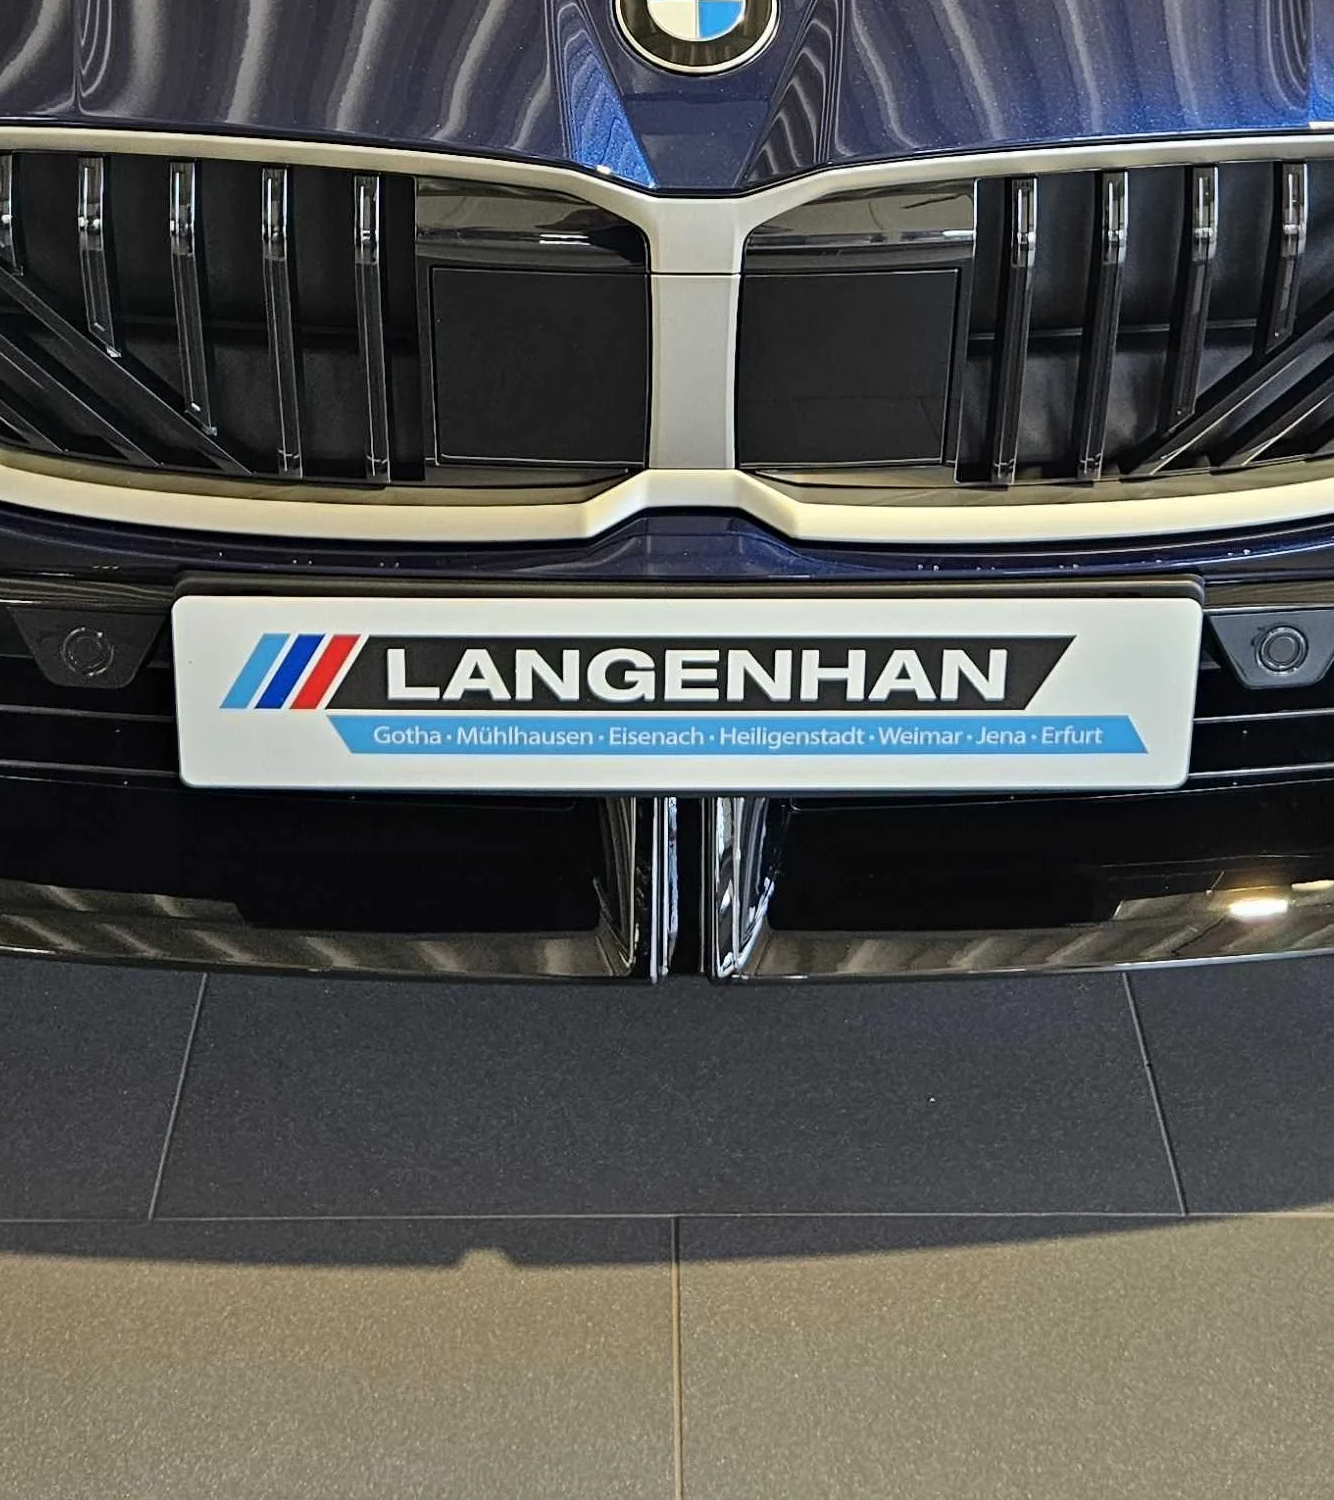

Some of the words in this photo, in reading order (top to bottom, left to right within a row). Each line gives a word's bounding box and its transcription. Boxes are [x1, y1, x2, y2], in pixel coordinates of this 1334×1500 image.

[386, 648, 1009, 702] LANGENHAN
[373, 725, 443, 745] Gotha
[457, 725, 593, 746] Mühlhausen
[609, 726, 704, 747] Eisenach
[719, 726, 865, 750] Heiligenstadt
[877, 726, 961, 746] Weimar
[976, 727, 1027, 746] Jena
[1042, 726, 1103, 746] Erfurt
